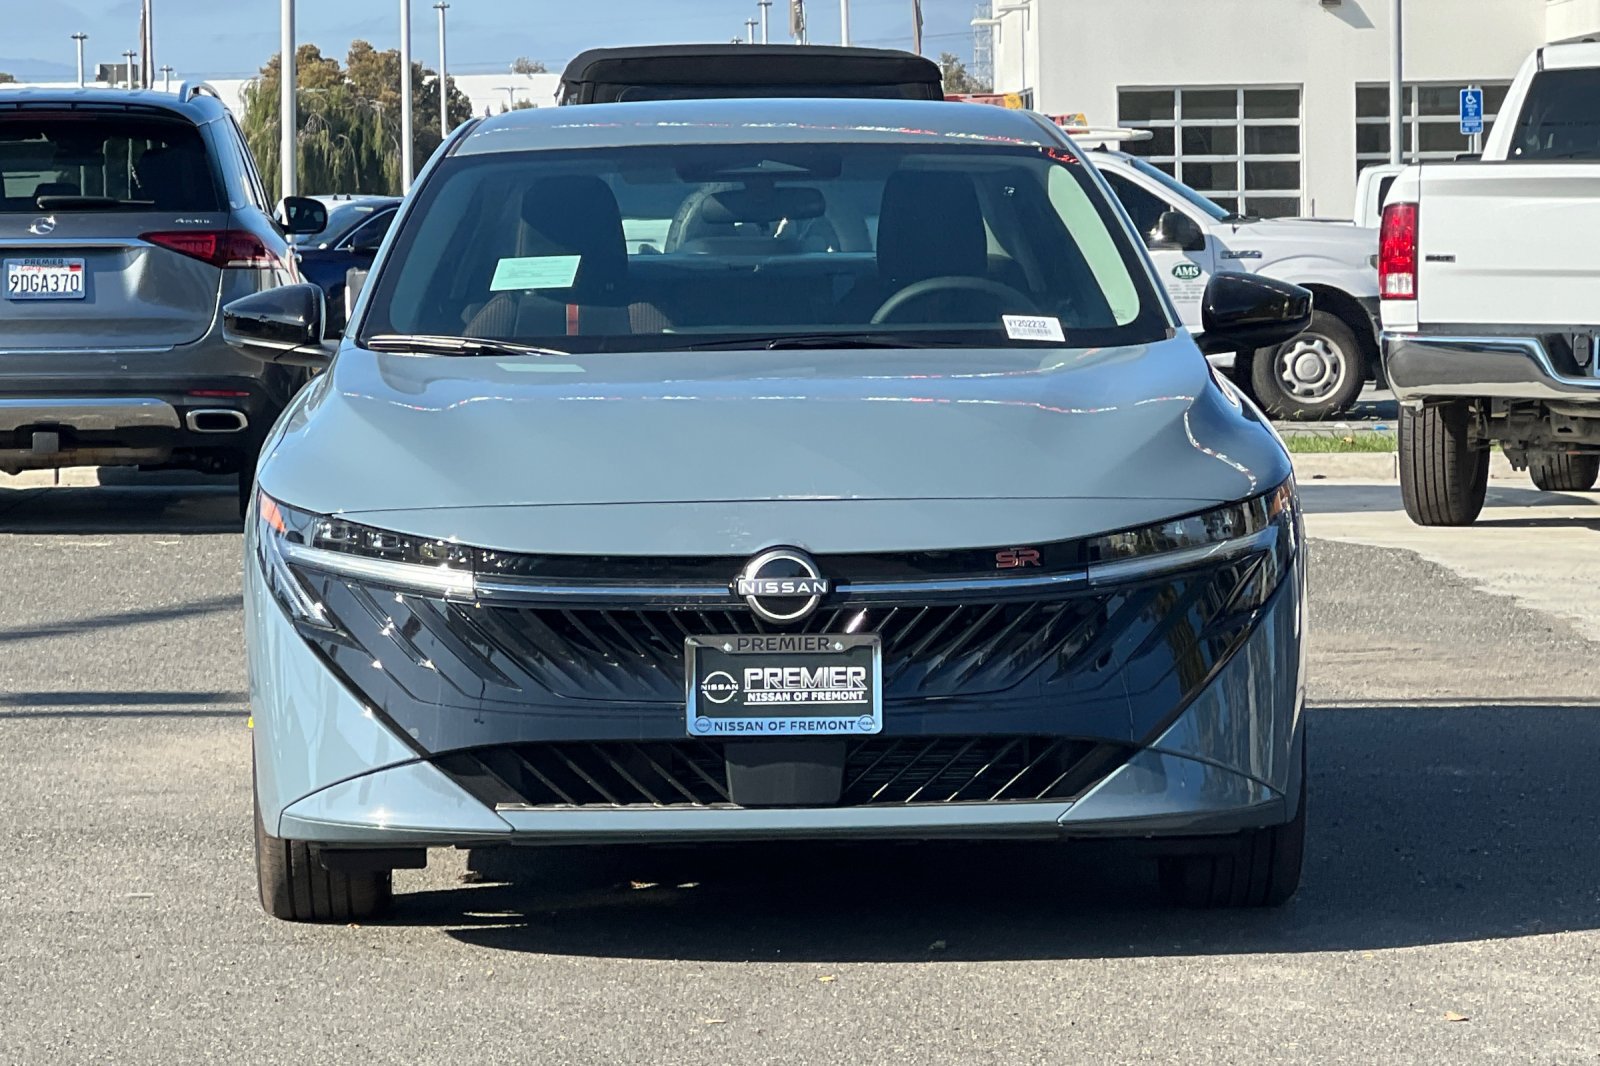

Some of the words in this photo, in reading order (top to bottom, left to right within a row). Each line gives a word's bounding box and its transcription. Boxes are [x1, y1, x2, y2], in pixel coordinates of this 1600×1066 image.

[1175, 266, 1199, 276] AMS
[10, 274, 79, 292] 9DGA370
[996, 549, 1041, 568] SR
[741, 581, 827, 593] NISSAN
[737, 637, 830, 651] PREMIER
[744, 666, 867, 690] PREMIER
[747, 692, 791, 702] NISSAN
[793, 691, 809, 701] OF
[811, 691, 864, 701] FREMONT
[714, 721, 764, 731] NISSAN
[768, 721, 786, 731] OF
[790, 720, 856, 731] FREMONT
